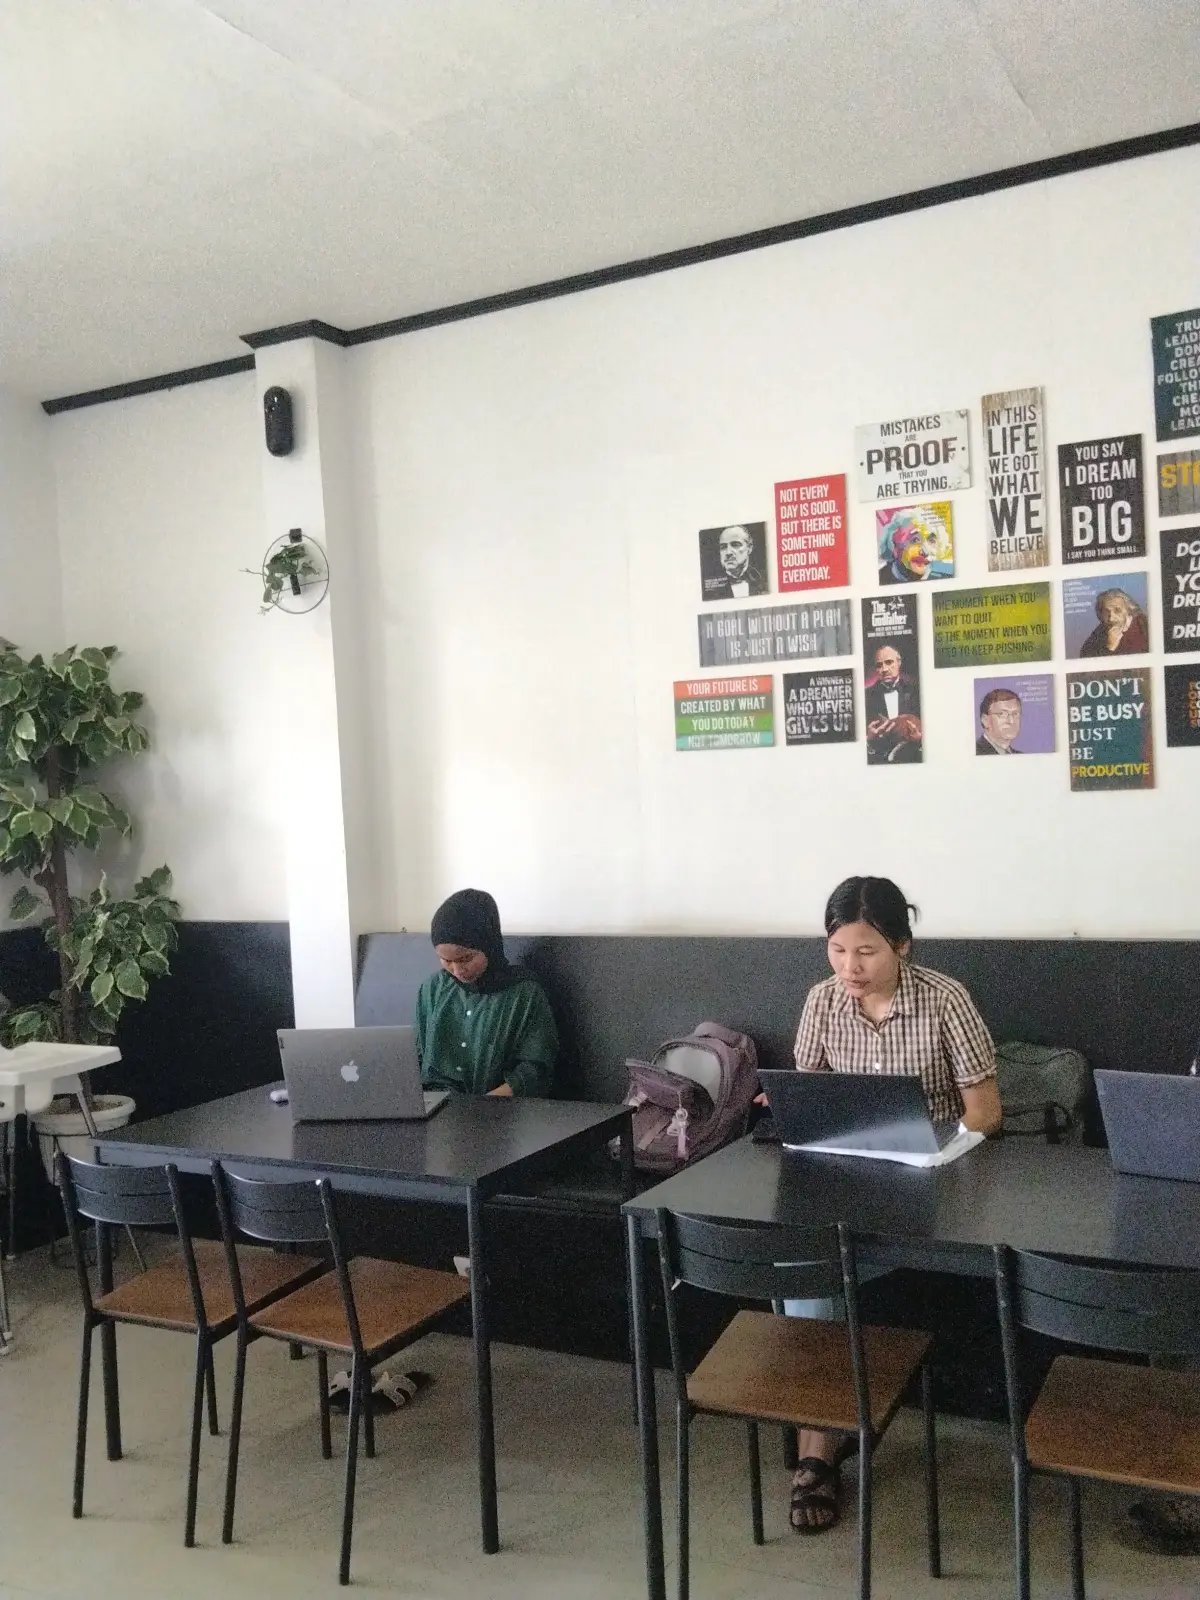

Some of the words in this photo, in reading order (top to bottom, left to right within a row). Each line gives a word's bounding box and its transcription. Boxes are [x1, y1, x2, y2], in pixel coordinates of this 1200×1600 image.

[1165, 331, 1200, 348] LEAD
[1157, 368, 1200, 385] FOLLO
[1180, 380, 1200, 393] TH
[987, 410, 1001, 426] IN
[1005, 404, 1037, 423] THIS
[880, 415, 941, 437] MISTAKES
[905, 434, 917, 442] ARE
[988, 422, 1038, 457] LIFE
[866, 436, 958, 475] PROOF
[1075, 445, 1098, 461] YOU
[1102, 441, 1124, 458] SAY
[989, 457, 1009, 474] WE
[1013, 453, 1039, 472] GOT
[1065, 467, 1070, 487] I
[1076, 458, 1137, 485] DREAM
[899, 471, 913, 480] THAT
[916, 469, 928, 478] YOU
[989, 471, 1040, 497] WHAT
[780, 487, 798, 503] NOT
[800, 483, 829, 500] EVERY
[877, 482, 900, 499] ARE
[903, 476, 951, 494] TRYING.
[1090, 485, 1113, 500] TOO
[780, 504, 798, 519] DAY
[800, 503, 809, 517] IS
[811, 500, 838, 516] GOOD.
[988, 493, 1043, 538] WE
[781, 521, 799, 535] BUT
[801, 516, 831, 533] THERE
[832, 515, 842, 530] IS
[1072, 500, 1132, 547] BIG
[781, 533, 835, 552] SOMETHING
[990, 535, 1043, 555] BELIEVE
[782, 552, 806, 568] GOOD
[808, 551, 818, 565] IN
[1071, 550, 1083, 559] SAY
[1084, 549, 1096, 558] YOU
[783, 565, 831, 584] EVERYDAY.
[871, 600, 886, 613] The
[952, 596, 989, 611] MOMENT
[990, 593, 1017, 606] WHEN
[1019, 592, 1036, 604] YOU
[706, 621, 713, 639] A
[717, 618, 744, 638] GOAL
[748, 613, 798, 635] WITHOUT
[801, 611, 809, 630] A
[813, 608, 841, 628] PLAN
[935, 615, 958, 627] WANT
[960, 614, 971, 625] TO
[973, 612, 992, 624] QUIT
[945, 631, 961, 642] THE
[963, 627, 1000, 641] MOMENT
[1002, 625, 1029, 637] WHEN
[1030, 624, 1048, 636] YOU
[730, 641, 741, 658] IS
[745, 637, 773, 657] JUST
[787, 633, 817, 653] WISH
[687, 683, 710, 696] YOUR
[712, 679, 747, 694] FUTURE
[749, 679, 758, 692] IS
[809, 677, 815, 686] A
[816, 676, 844, 686] WINNER
[1068, 677, 1144, 700] DON'T
[789, 688, 797, 702] A
[800, 685, 852, 701] DREAMER
[680, 699, 721, 714] CREATED
[723, 699, 736, 712] BY
[738, 697, 766, 710] WHAT
[786, 701, 814, 716] WHO
[816, 699, 852, 715] NEVER
[1069, 705, 1092, 722] BE
[1097, 702, 1145, 721] BUSY
[692, 718, 710, 731] YOU
[712, 717, 724, 731] DO
[724, 715, 755, 729] TODAY
[786, 714, 829, 735] GIVES
[833, 713, 852, 732] UP
[1070, 727, 1116, 744] JUST
[1071, 747, 1094, 760] BE
[1071, 763, 1150, 777] PRODUCTIVE
